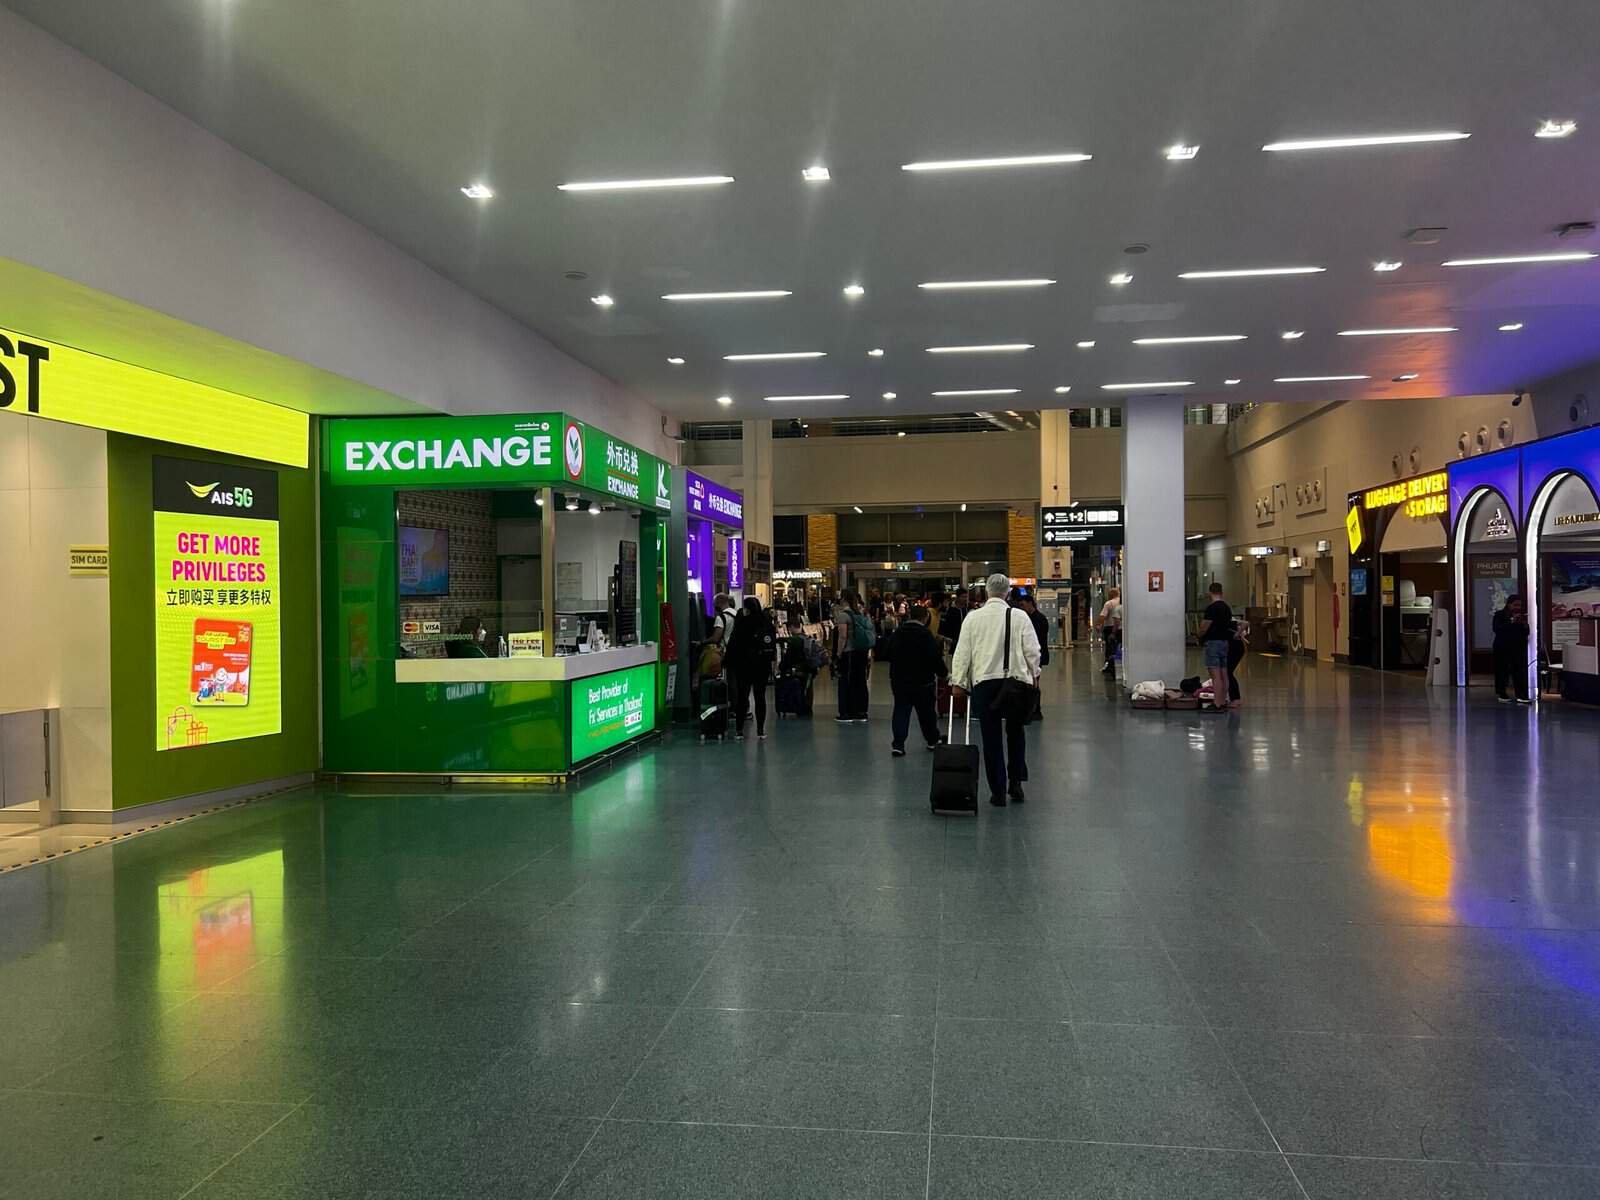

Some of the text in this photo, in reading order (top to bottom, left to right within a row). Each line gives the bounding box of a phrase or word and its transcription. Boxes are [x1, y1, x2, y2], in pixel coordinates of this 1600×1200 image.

[345, 436, 552, 471] EXCHANGE
[211, 487, 253, 508] AIS 5G
[607, 475, 639, 499] EXCHANGE
[1365, 483, 1407, 509] LUGGAGE
[1069, 511, 1084, 522] 1-2
[178, 532, 260, 557] GET MORE
[71, 555, 108, 565] SIM CARD
[172, 560, 266, 583] PRIVILEGES
[787, 570, 823, 579] Amazon
[167, 588, 271, 606] 立即购买 享更多特权
[424, 623, 440, 631] VISA
[589, 688, 601, 704] Best
[601, 680, 622, 701] Provider
[597, 704, 619, 723] Services
[624, 692, 643, 712] Thailand
